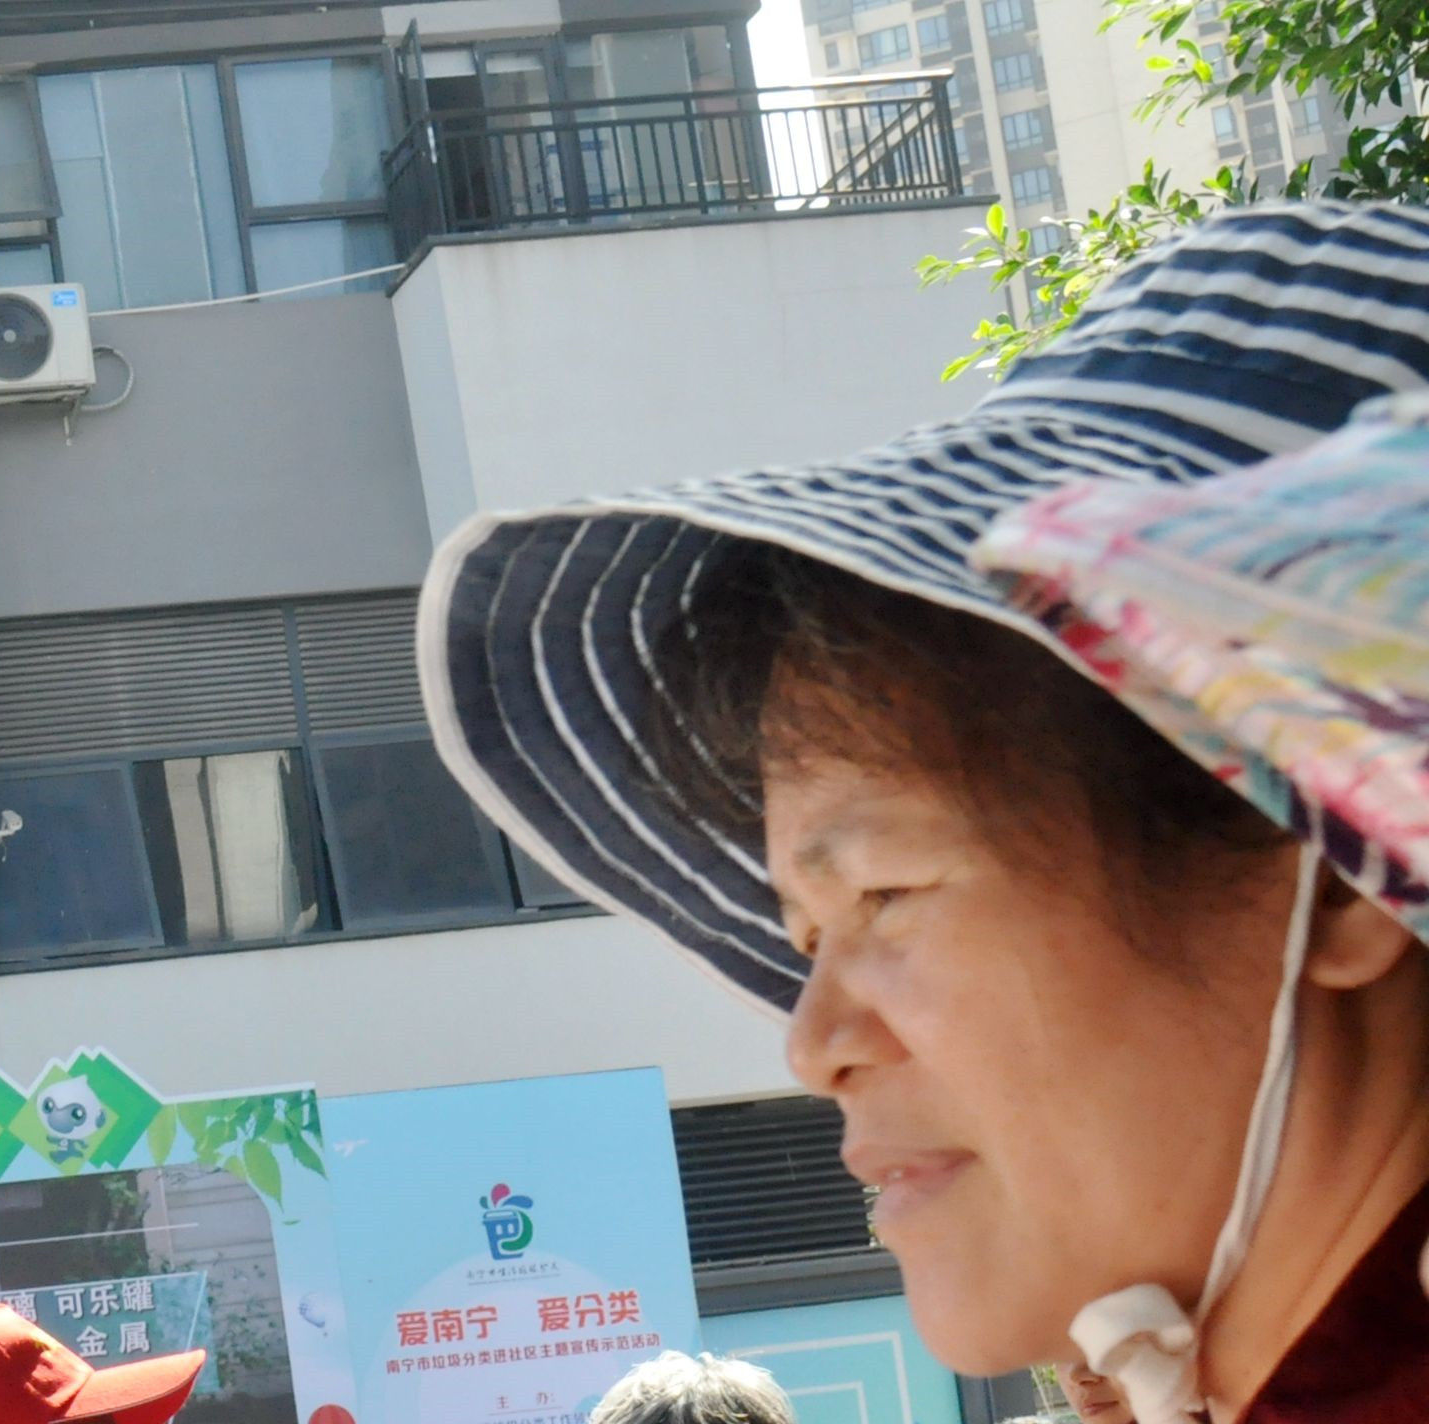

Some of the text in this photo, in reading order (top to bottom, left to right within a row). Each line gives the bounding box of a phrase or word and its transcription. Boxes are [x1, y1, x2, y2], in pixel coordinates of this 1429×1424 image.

[54, 1280, 155, 1319] 可乐罐
[396, 1290, 640, 1346] 爱南宁 爱分类
[76, 1320, 151, 1358] 金属
